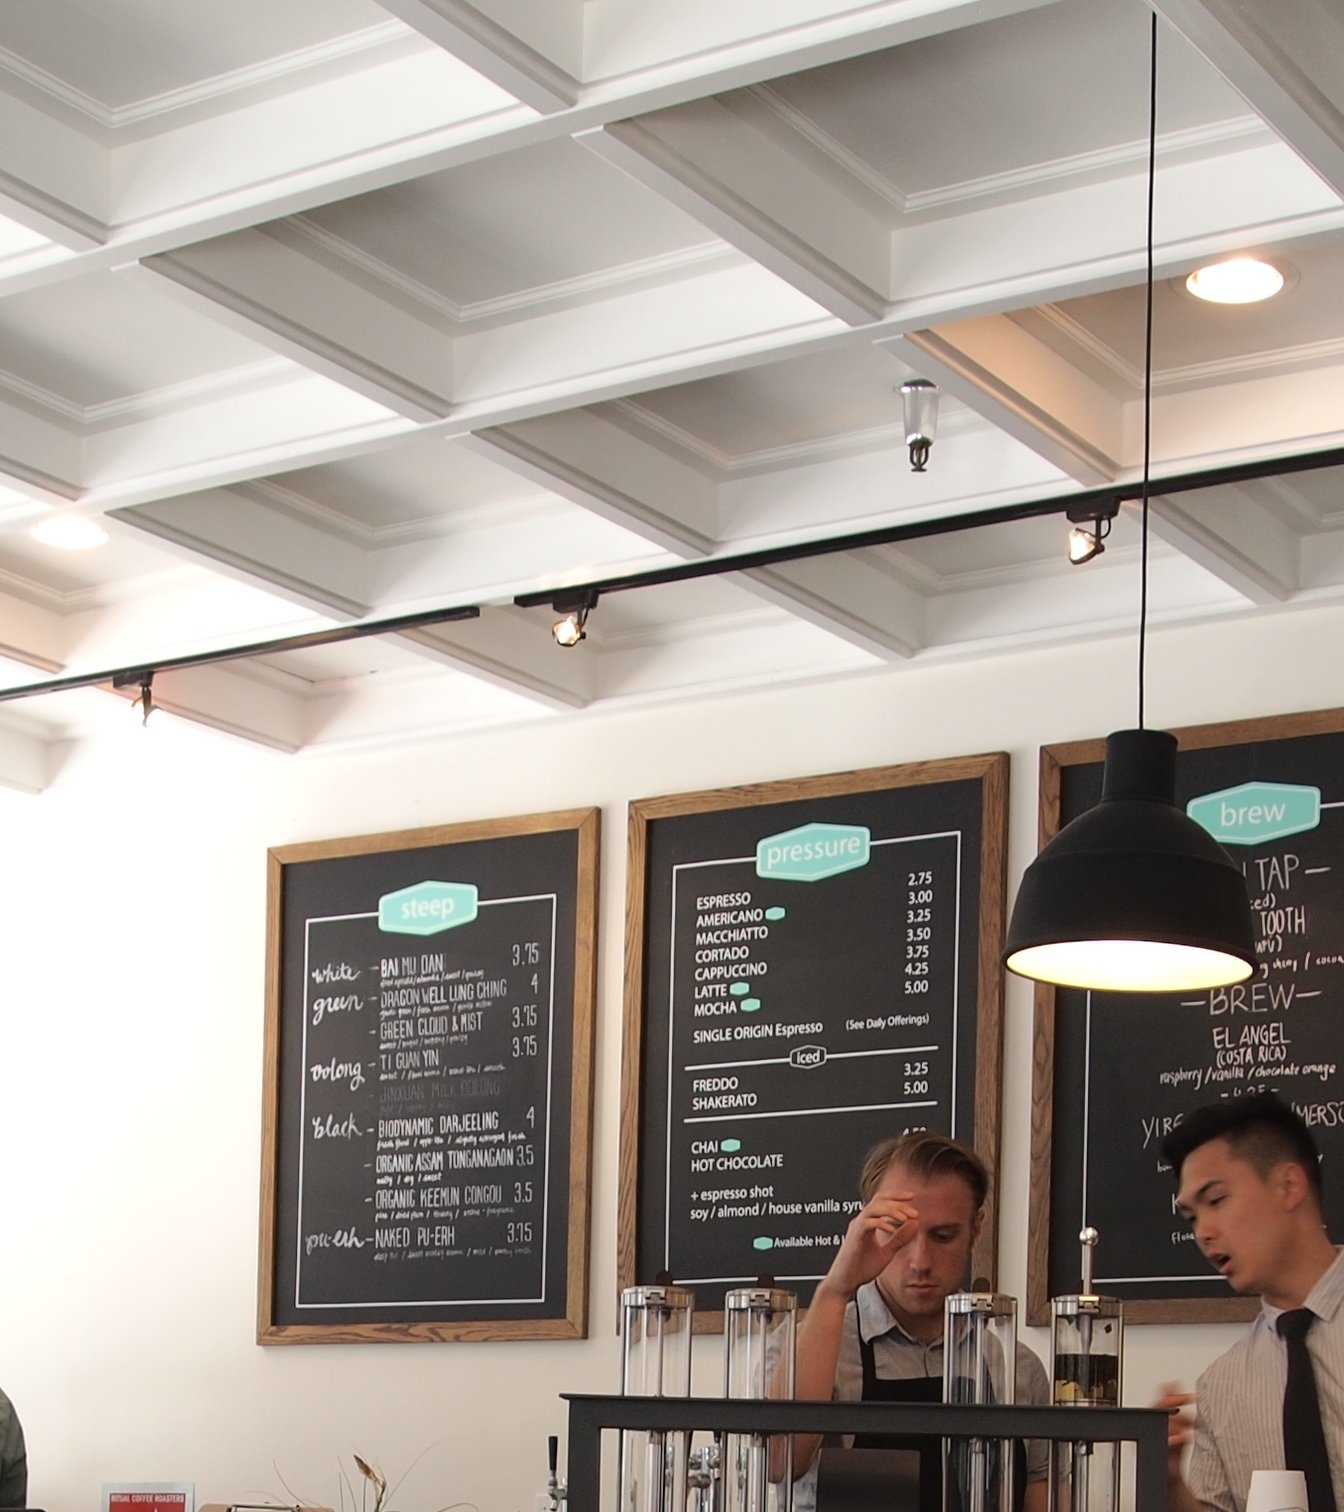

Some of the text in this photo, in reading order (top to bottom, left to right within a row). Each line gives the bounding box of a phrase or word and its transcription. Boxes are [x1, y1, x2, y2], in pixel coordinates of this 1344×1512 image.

[1221, 802, 1286, 827] brew
[767, 837, 861, 870] pressure
[908, 871, 933, 886] 2.75
[1254, 854, 1300, 891] TAP
[696, 892, 751, 911] ESPRESSO
[908, 889, 933, 905] 3.00
[401, 898, 454, 919] steep
[695, 907, 763, 928] AMERICANO
[907, 908, 931, 923] 3.25
[1260, 905, 1306, 937] TOOTH
[695, 926, 768, 946] MACCHIATTO
[907, 927, 931, 941] 3.50
[695, 945, 749, 963] CORTADO
[906, 945, 929, 959] 3.75
[1316, 955, 1344, 965] cocoa
[312, 962, 360, 984] white
[380, 957, 398, 978] BAI
[421, 953, 444, 973] DAN
[512, 943, 540, 966] 3.75
[694, 961, 768, 981] CAPPUCCINO
[904, 961, 929, 975] 4.25
[695, 983, 728, 999] LATTE
[904, 980, 929, 994] 5.00
[313, 994, 364, 1026] green
[380, 985, 420, 1008] DRAGON
[422, 983, 447, 1004] WELL
[476, 978, 508, 999] CHING
[530, 973, 539, 994] 4
[694, 1001, 737, 1017] MOCHA
[1209, 983, 1296, 1016] BREW
[380, 1019, 413, 1041] GREEN
[418, 1016, 448, 1036] CLOUD
[460, 1011, 483, 1032] MIST
[512, 1005, 538, 1028] 3.75
[693, 1012, 930, 1044] SINGLE ORIGIN Espresso (See Daily Offerings)
[1212, 1022, 1291, 1050] EL ANGEL
[310, 1035, 538, 1092] oolong TI GUAN YIN 3.75
[796, 1049, 821, 1065] iced
[1216, 1045, 1287, 1069] (COSTA RICA)
[904, 1062, 929, 1076] 3.25
[1159, 1066, 1203, 1091] raspberry
[1302, 1062, 1337, 1082] orange
[693, 1076, 739, 1092] FREDDO
[904, 1080, 929, 1095] 5.00
[692, 1093, 758, 1111] SHAKERATO
[312, 1105, 535, 1140] black BIODYNAMIC DARJEELING 4
[691, 1141, 718, 1154] CHAI
[376, 1154, 413, 1173] ORGANIC
[414, 1150, 443, 1172] ASSAM
[516, 1145, 534, 1167] 3.5
[691, 1153, 784, 1173] HOT CHOCOLATE
[375, 1182, 533, 1210] ORGANIC KEEMUN CONGOU 3.5
[700, 1189, 748, 1204] espresso
[750, 1185, 774, 1199] shot
[690, 1208, 709, 1222] soy
[718, 1204, 760, 1218] almond
[769, 1202, 802, 1215] house
[803, 1199, 840, 1214] vanilla
[306, 1226, 365, 1256] pu-erh
[375, 1228, 410, 1249] NAKED
[418, 1225, 455, 1246] PU-ERH
[507, 1222, 533, 1243] 3.75
[774, 1235, 813, 1248] Available
[815, 1234, 832, 1247] Hot
[131, 1494, 153, 1502] COFFEE
[154, 1494, 185, 1503] ROASTERS
